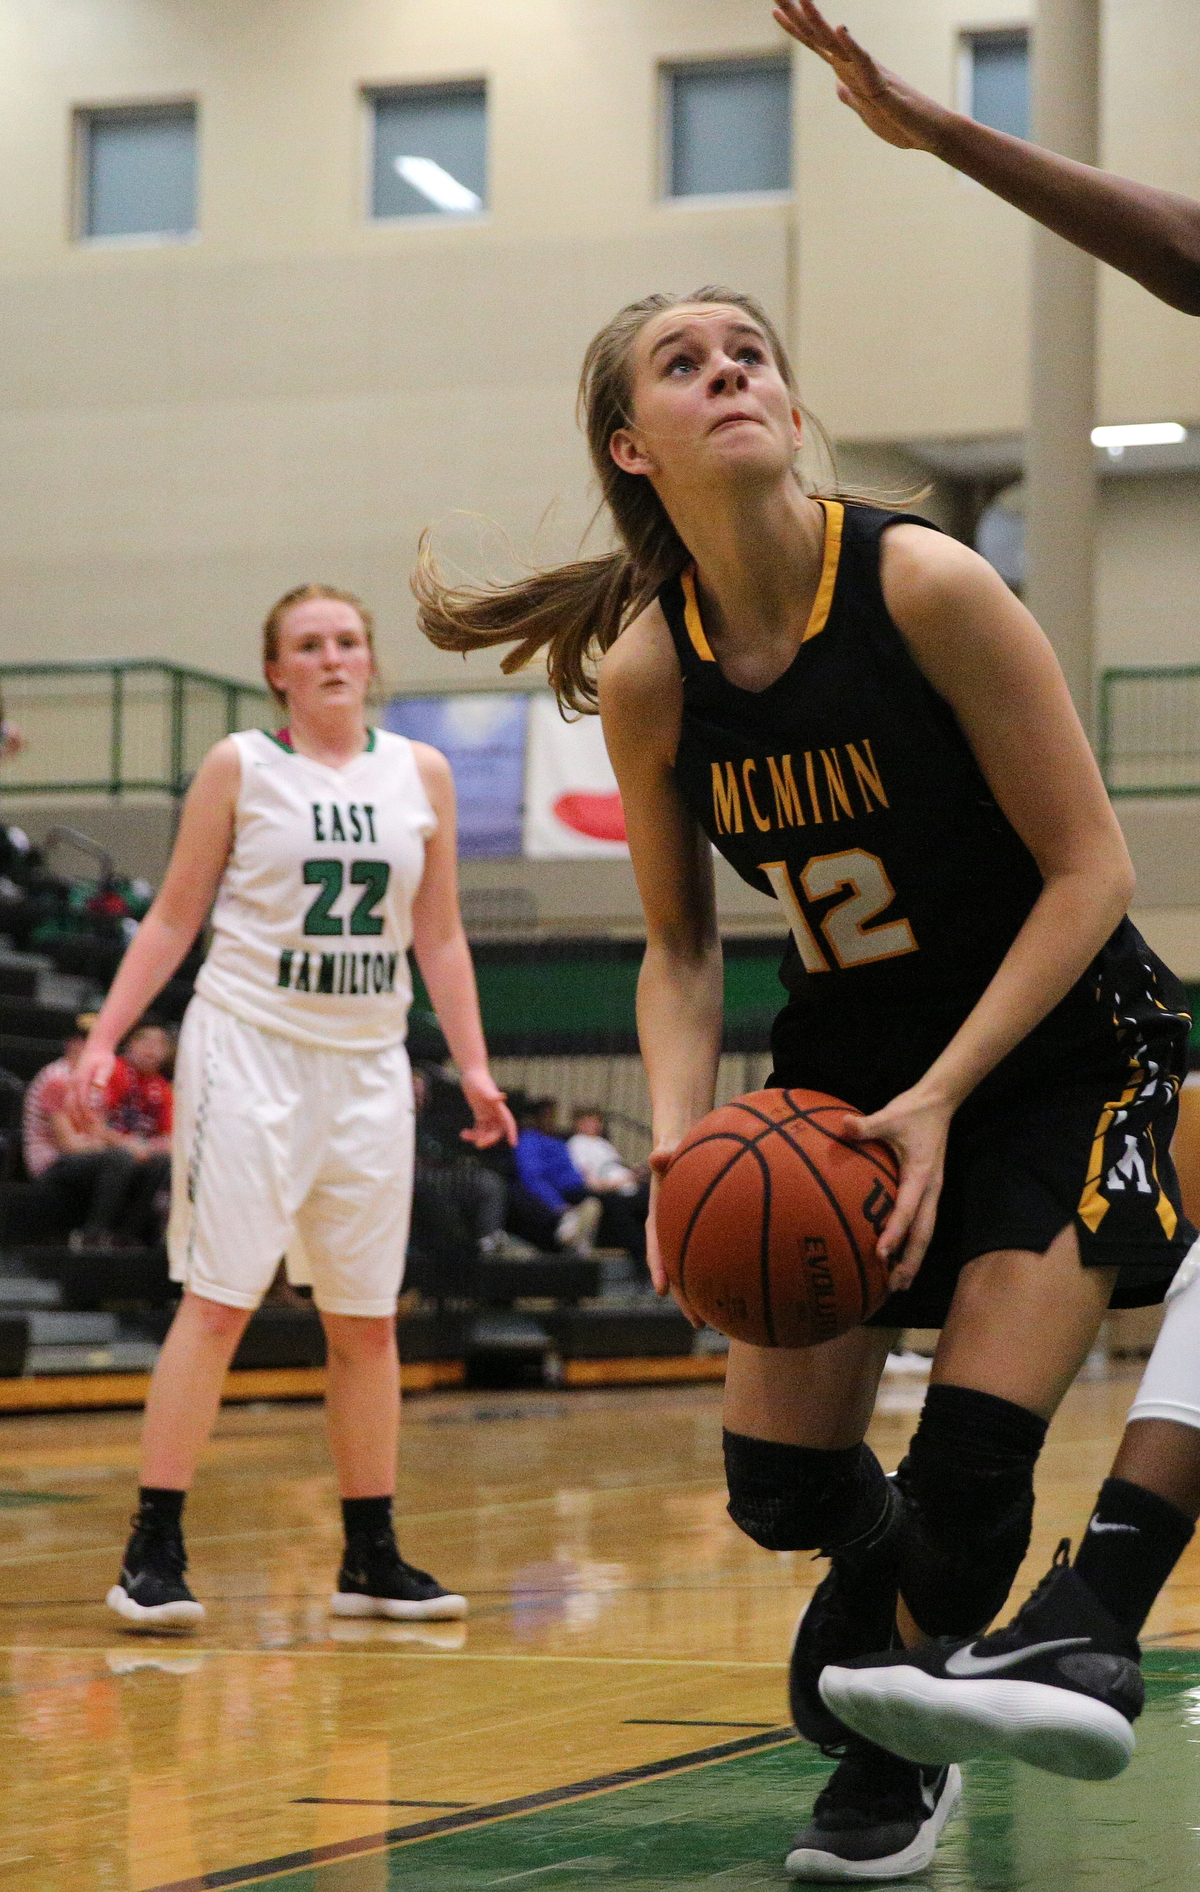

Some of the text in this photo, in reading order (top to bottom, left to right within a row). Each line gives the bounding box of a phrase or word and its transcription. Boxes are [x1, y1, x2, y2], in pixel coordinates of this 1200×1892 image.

[312, 803, 377, 843] EAST
[711, 738, 890, 834] MCMINN
[303, 858, 390, 936] 22
[756, 847, 919, 973] 12
